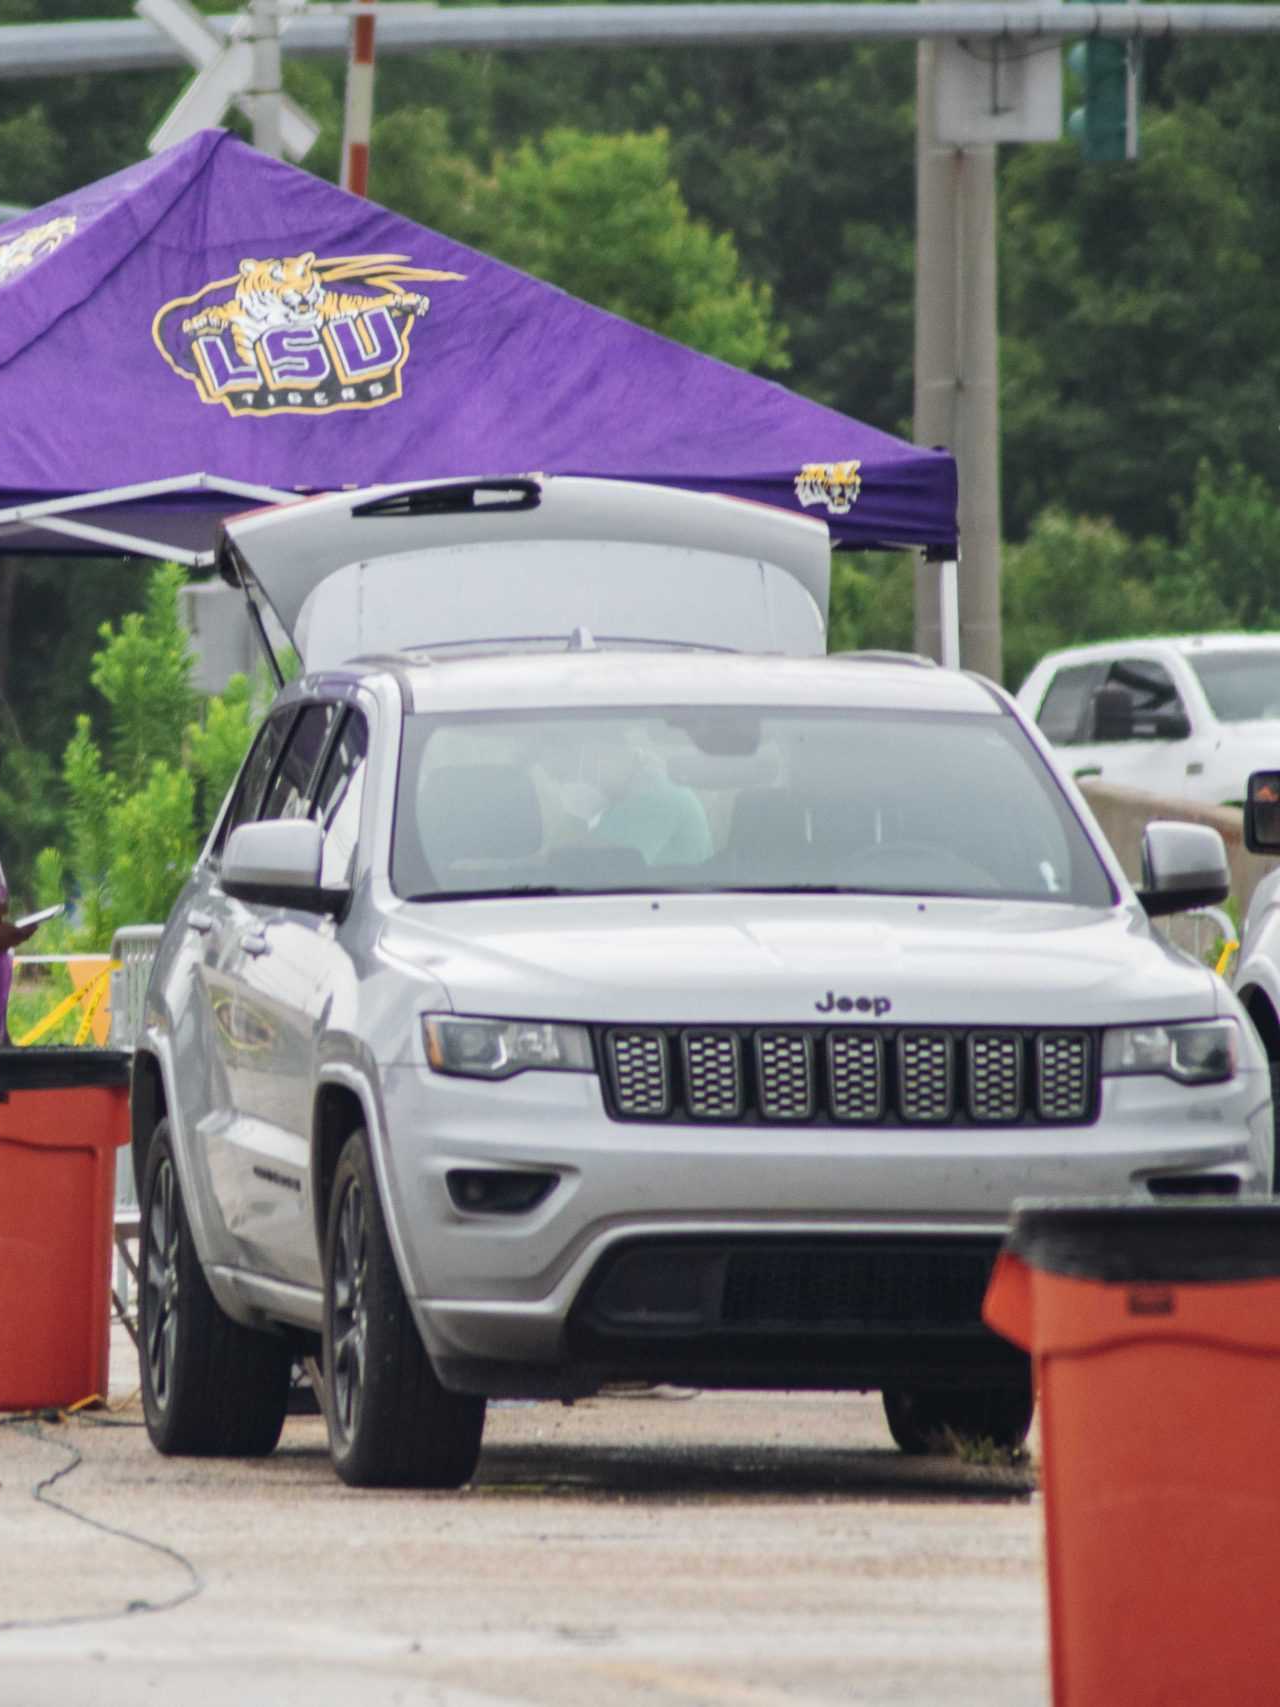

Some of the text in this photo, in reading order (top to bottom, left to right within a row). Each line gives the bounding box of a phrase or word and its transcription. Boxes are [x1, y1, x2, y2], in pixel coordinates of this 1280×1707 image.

[193, 307, 402, 393] LSU
[242, 382, 384, 406] TIGERS
[815, 990, 892, 1017] Jeep
